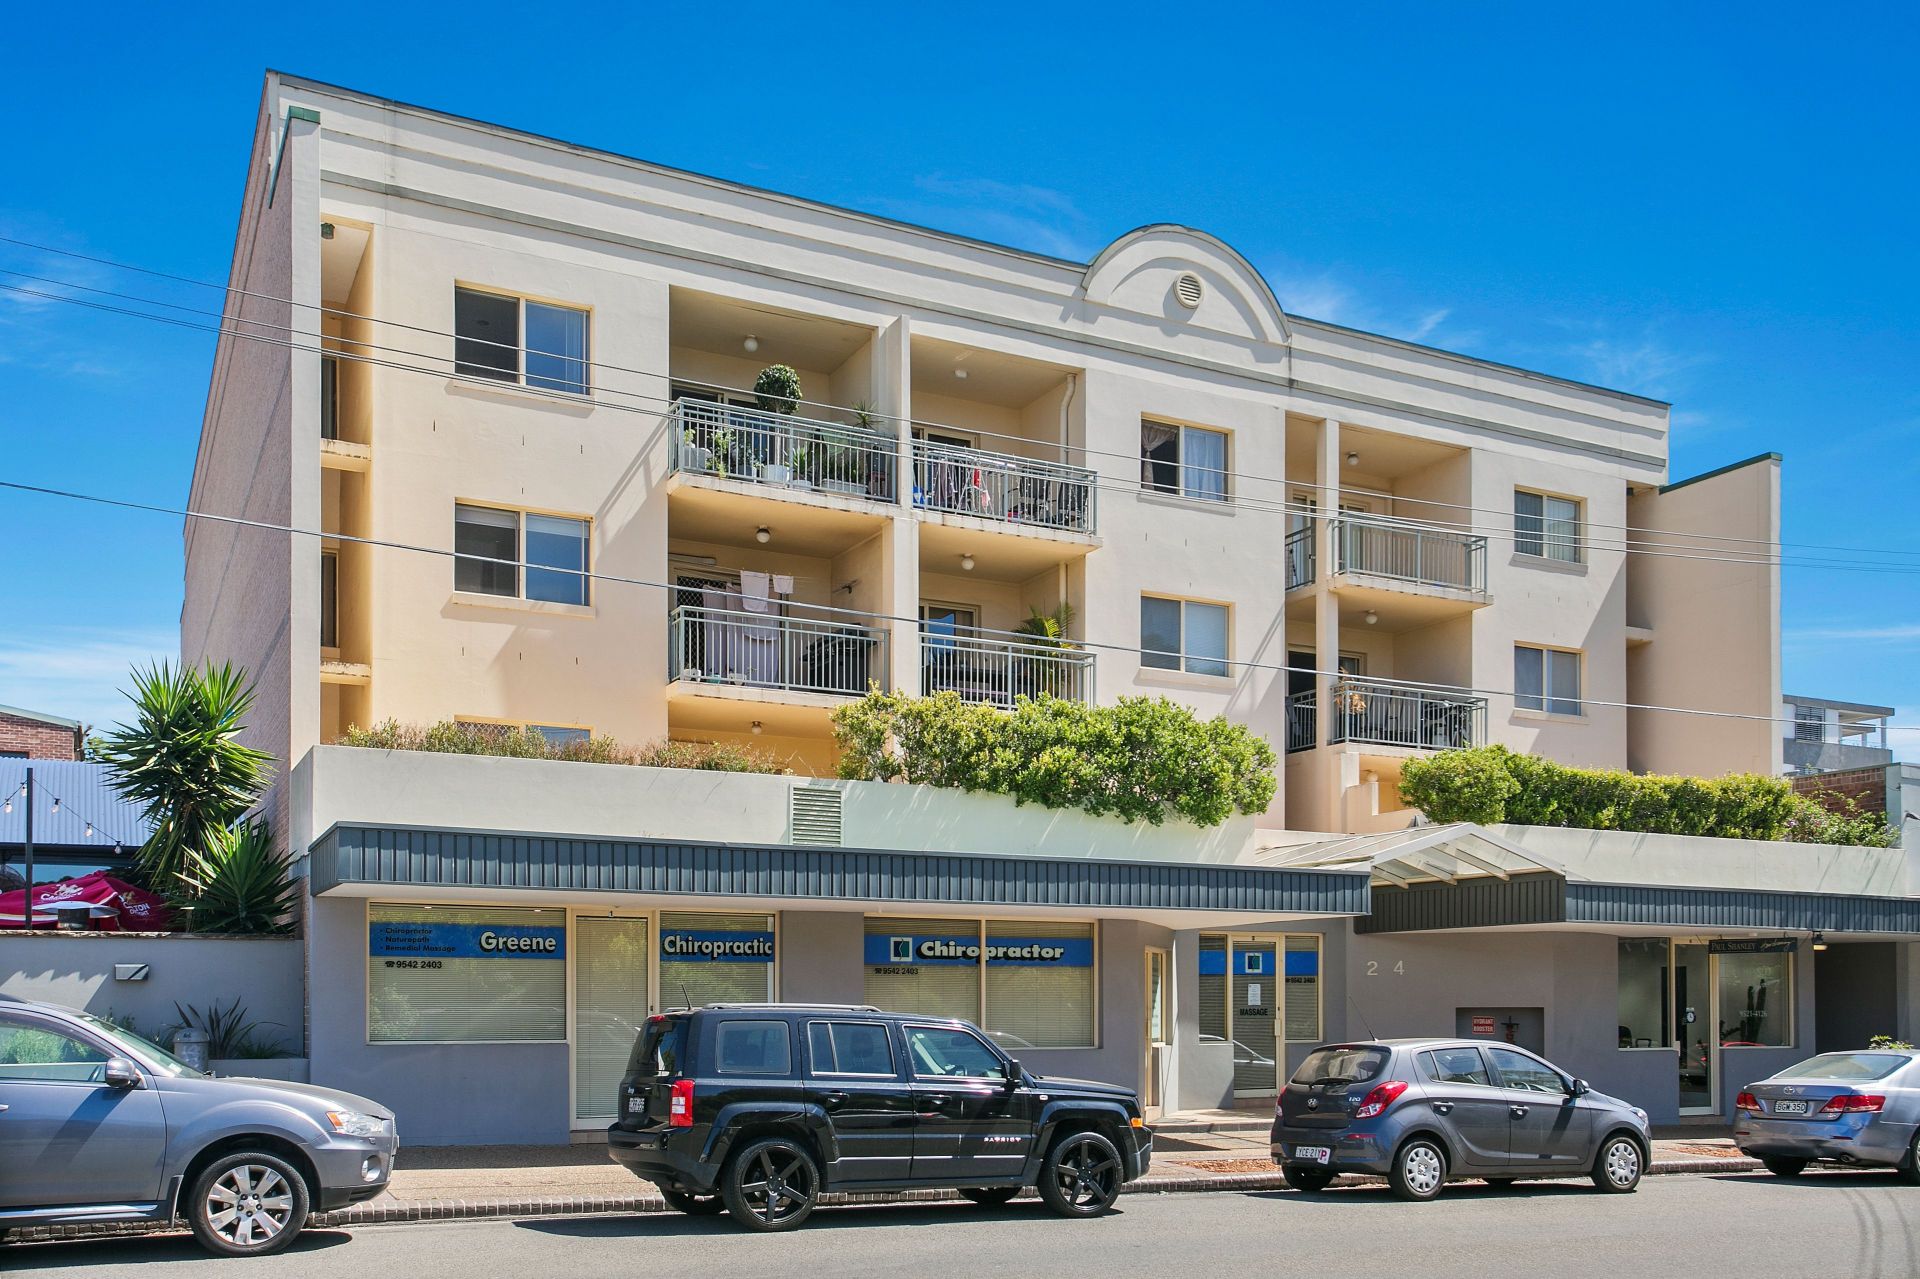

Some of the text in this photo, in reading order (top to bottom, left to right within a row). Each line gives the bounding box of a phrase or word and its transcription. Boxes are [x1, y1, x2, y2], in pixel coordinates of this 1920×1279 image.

[385, 936, 430, 944] Naturopath
[480, 930, 557, 953] Greene
[663, 935, 773, 959] Chiropractic
[917, 940, 1065, 963] Chiropractor
[396, 960, 442, 969] 9542 2403
[1239, 1008, 1269, 1016] MASSAGE
